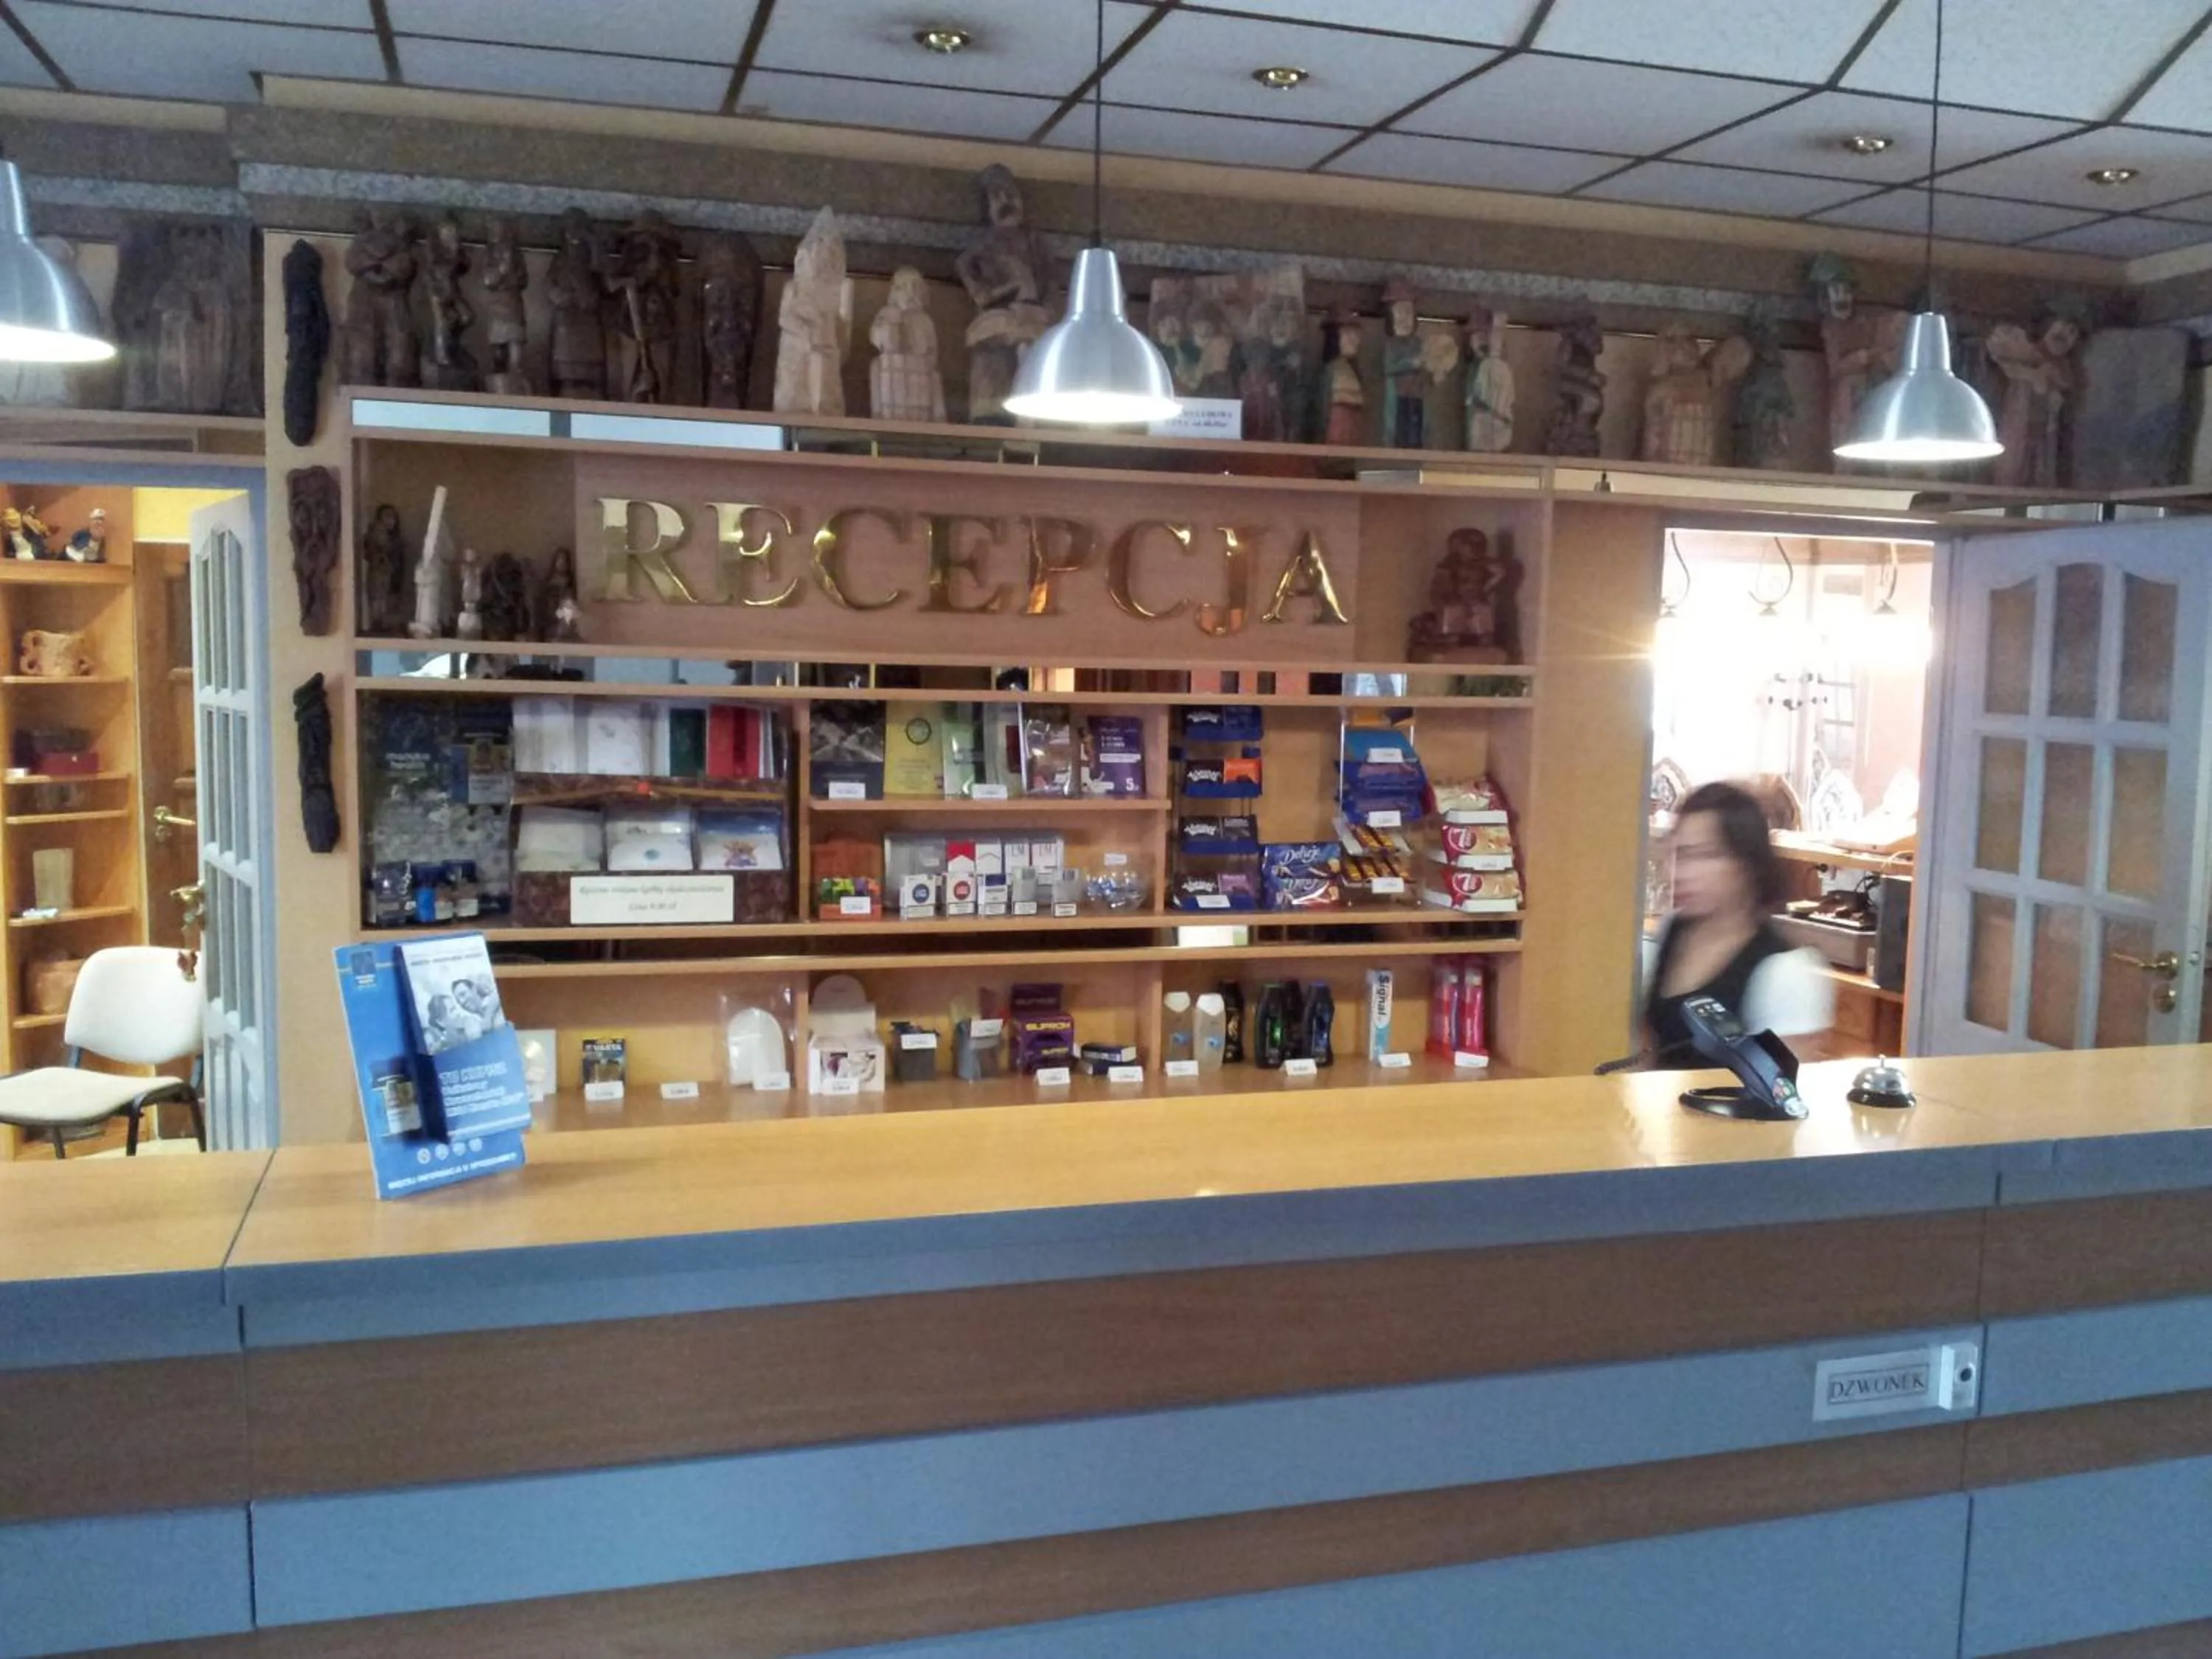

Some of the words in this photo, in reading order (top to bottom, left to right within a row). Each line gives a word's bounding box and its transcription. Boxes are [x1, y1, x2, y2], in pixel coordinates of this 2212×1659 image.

[594, 497, 1349, 635] RECEPCJA
[1376, 975, 1390, 1016] Signal
[1831, 1372, 1924, 1399] DZWONEK
